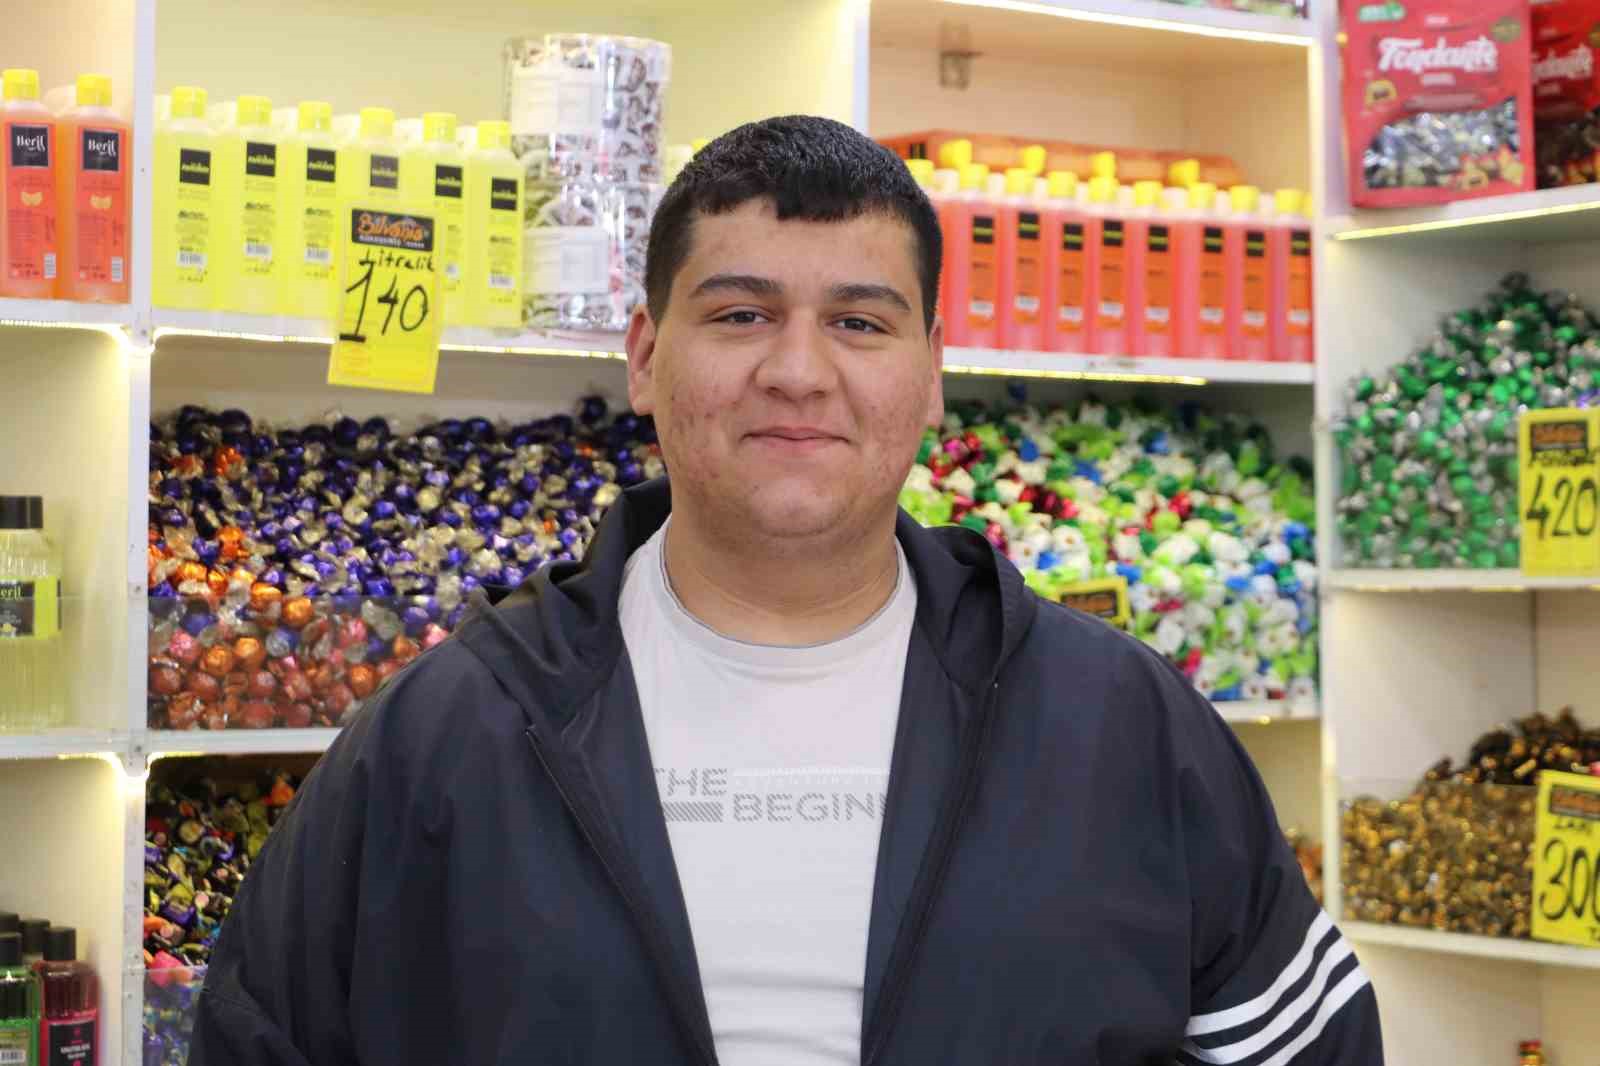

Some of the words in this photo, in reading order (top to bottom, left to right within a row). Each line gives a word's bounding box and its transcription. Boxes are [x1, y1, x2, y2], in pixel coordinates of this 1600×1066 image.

[16, 135, 46, 153] Beril
[88, 139, 117, 157] Beril
[339, 262, 429, 344] 140
[1526, 474, 1598, 541] 420
[0, 585, 24, 600] eril
[733, 792, 886, 822] BEGIN
